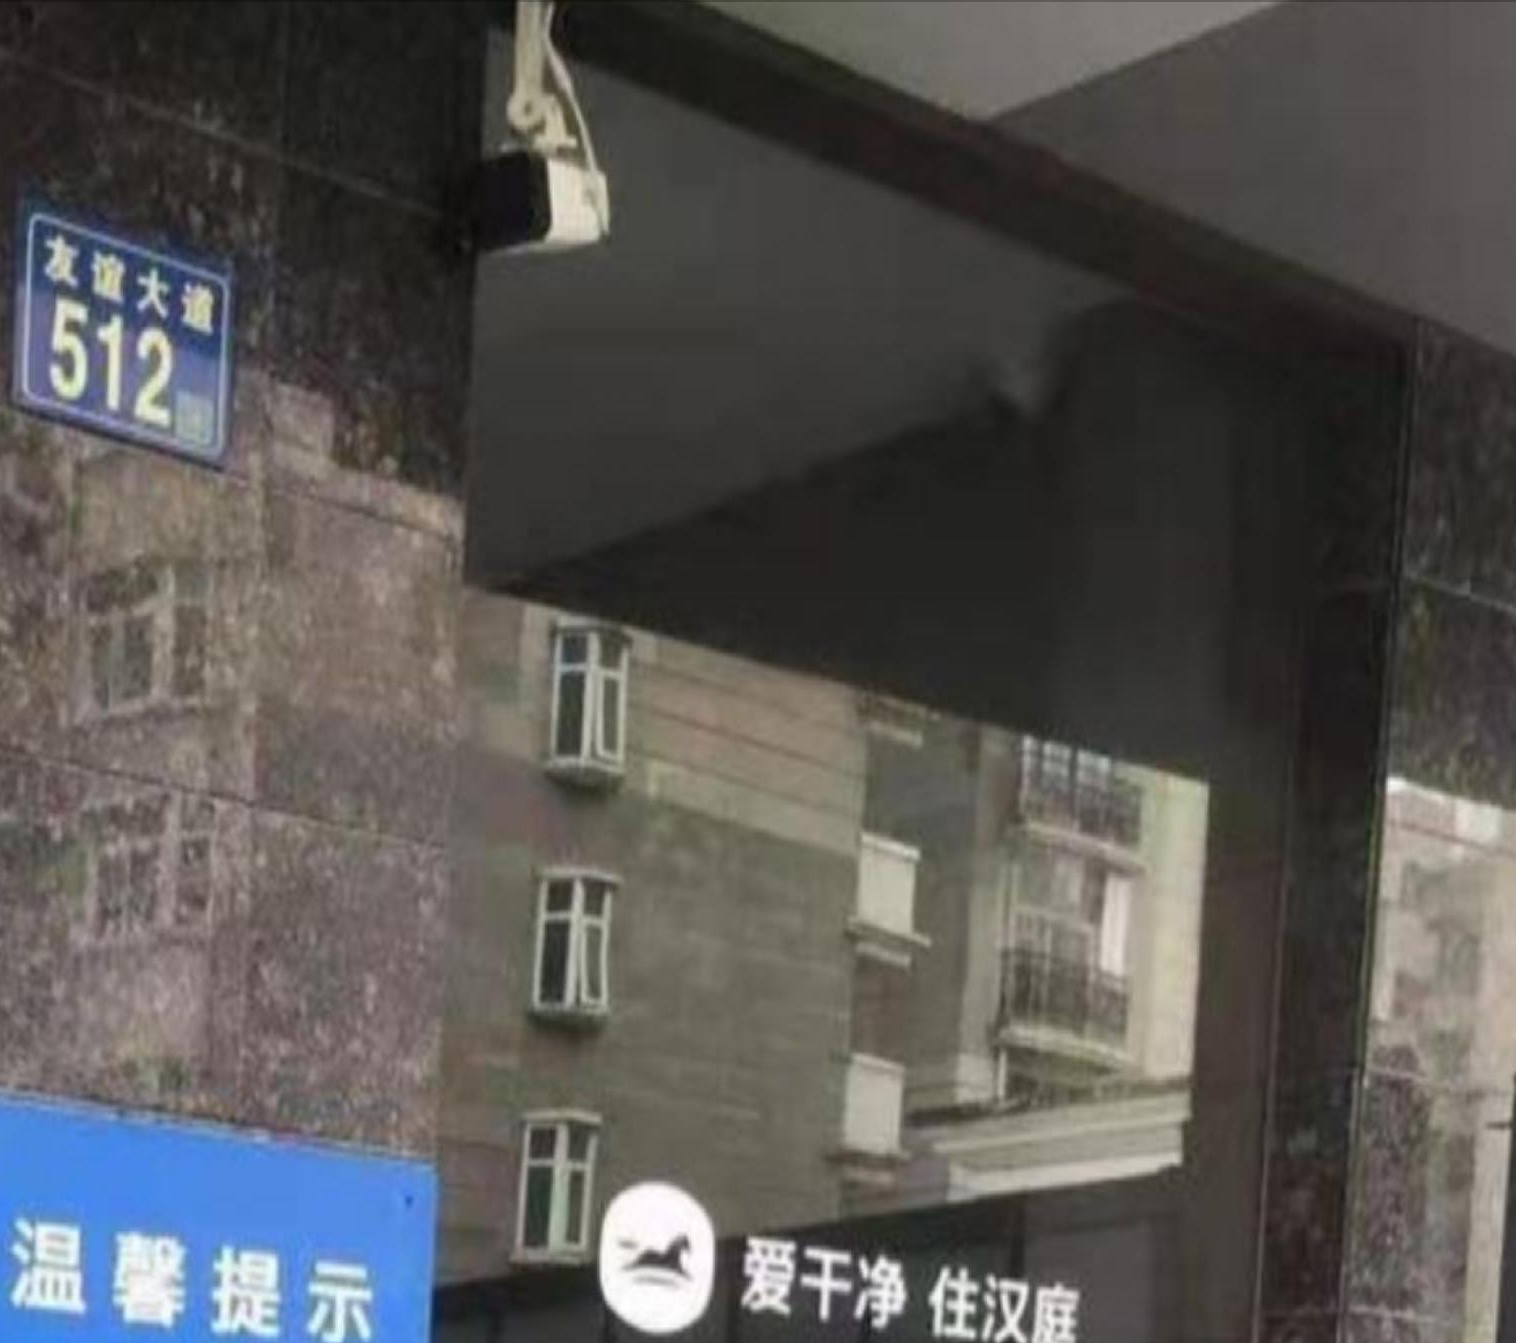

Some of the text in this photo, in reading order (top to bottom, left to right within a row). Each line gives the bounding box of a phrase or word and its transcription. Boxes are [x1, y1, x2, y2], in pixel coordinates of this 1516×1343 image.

[48, 293, 174, 429] 512
[741, 1235, 908, 1331] 爱干净
